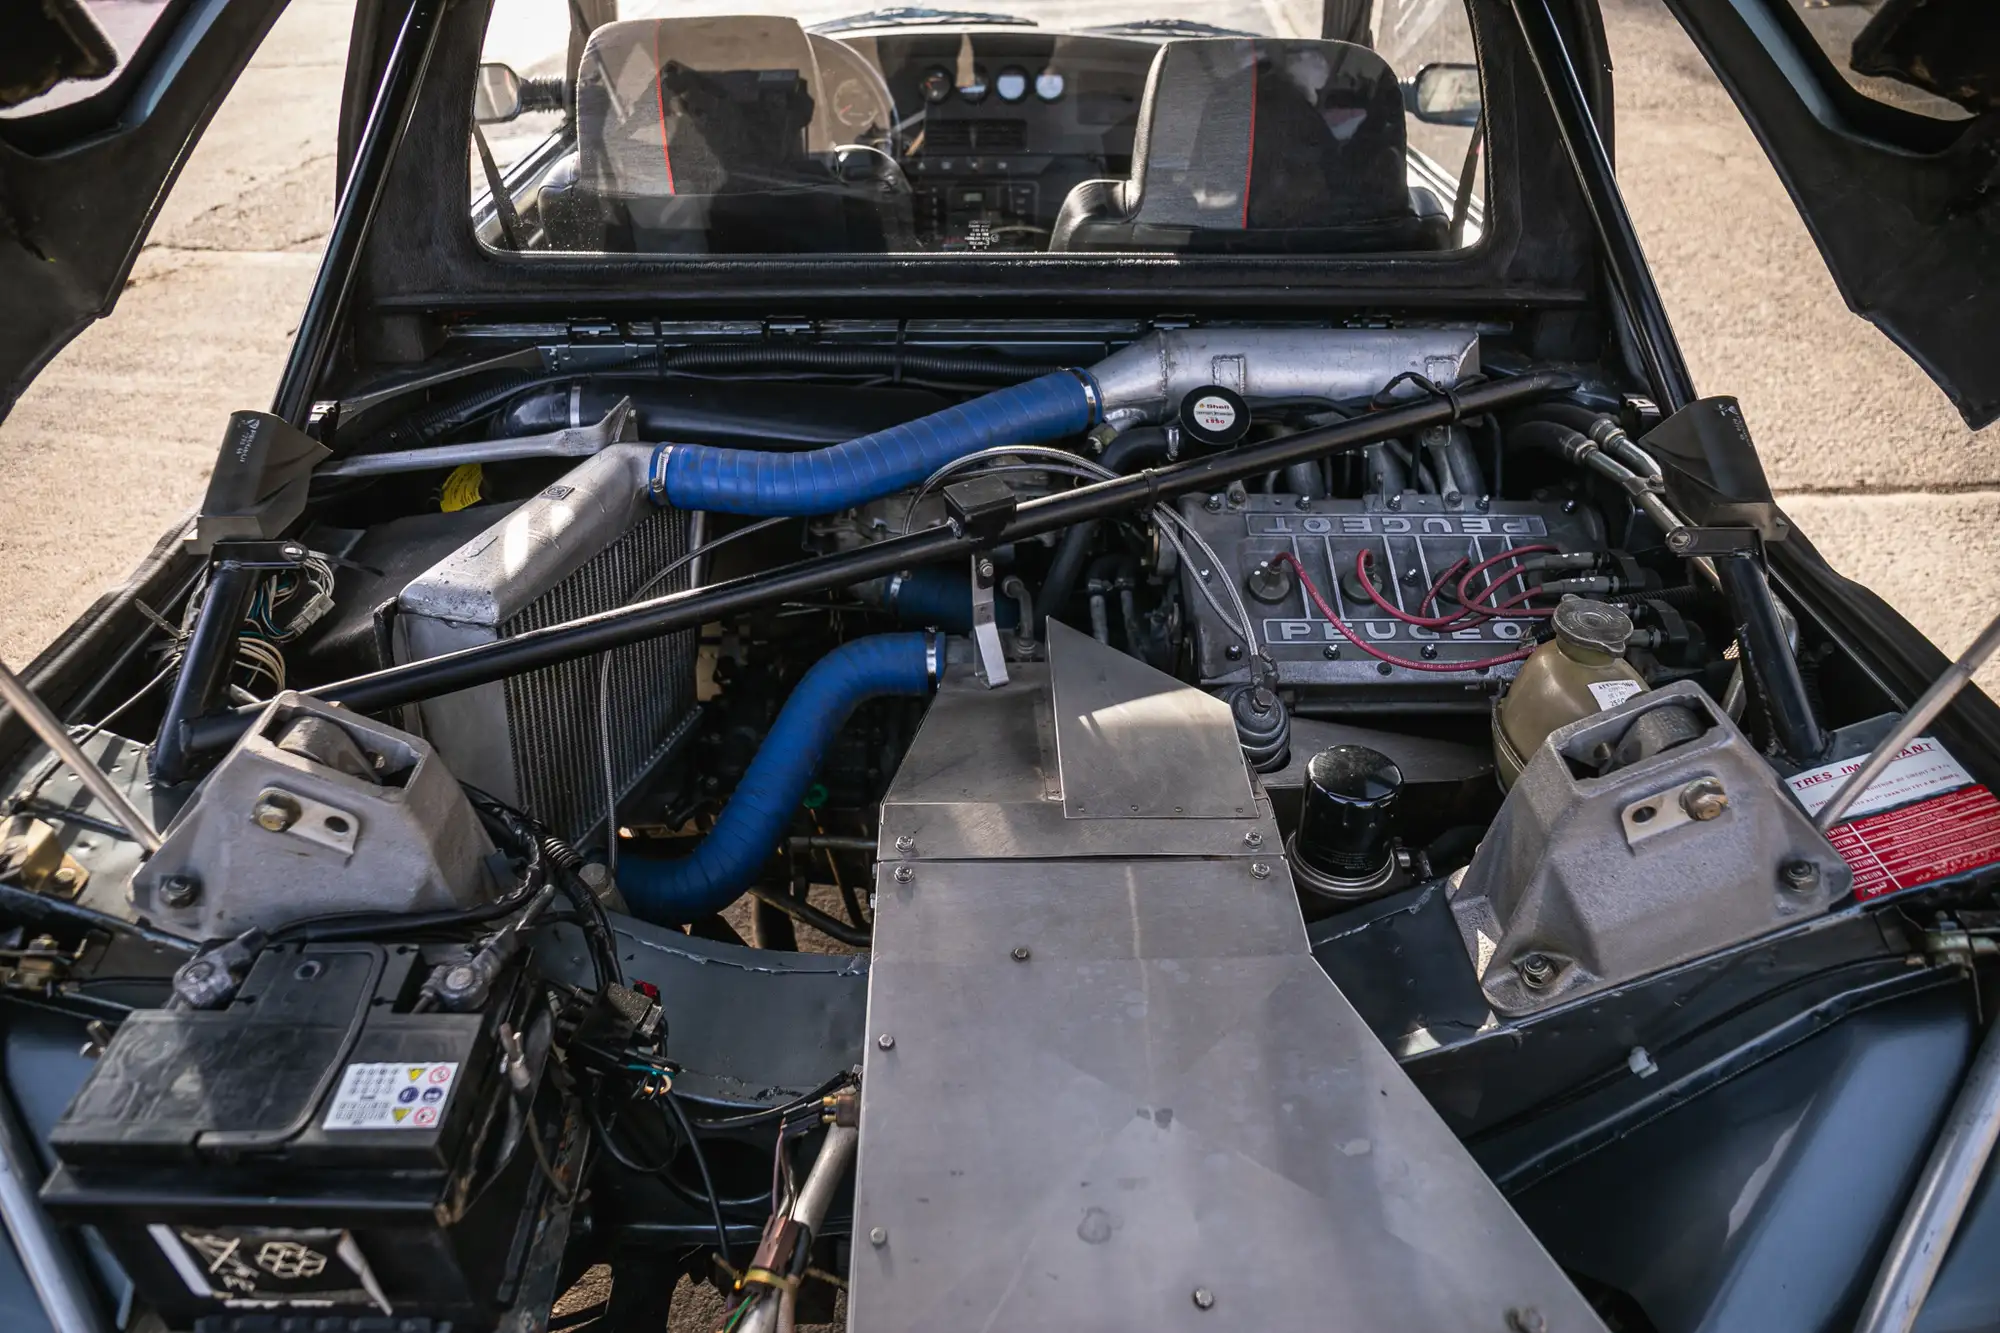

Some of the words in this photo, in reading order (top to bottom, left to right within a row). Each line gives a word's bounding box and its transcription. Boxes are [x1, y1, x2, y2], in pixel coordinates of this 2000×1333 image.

[1263, 516, 1532, 534] PEUGEOT
[1281, 621, 1522, 641] PEUGEO
[1792, 771, 1834, 790] TRES
[1841, 741, 1934, 775] IMANT
[1834, 837, 1857, 848] HTUNG
